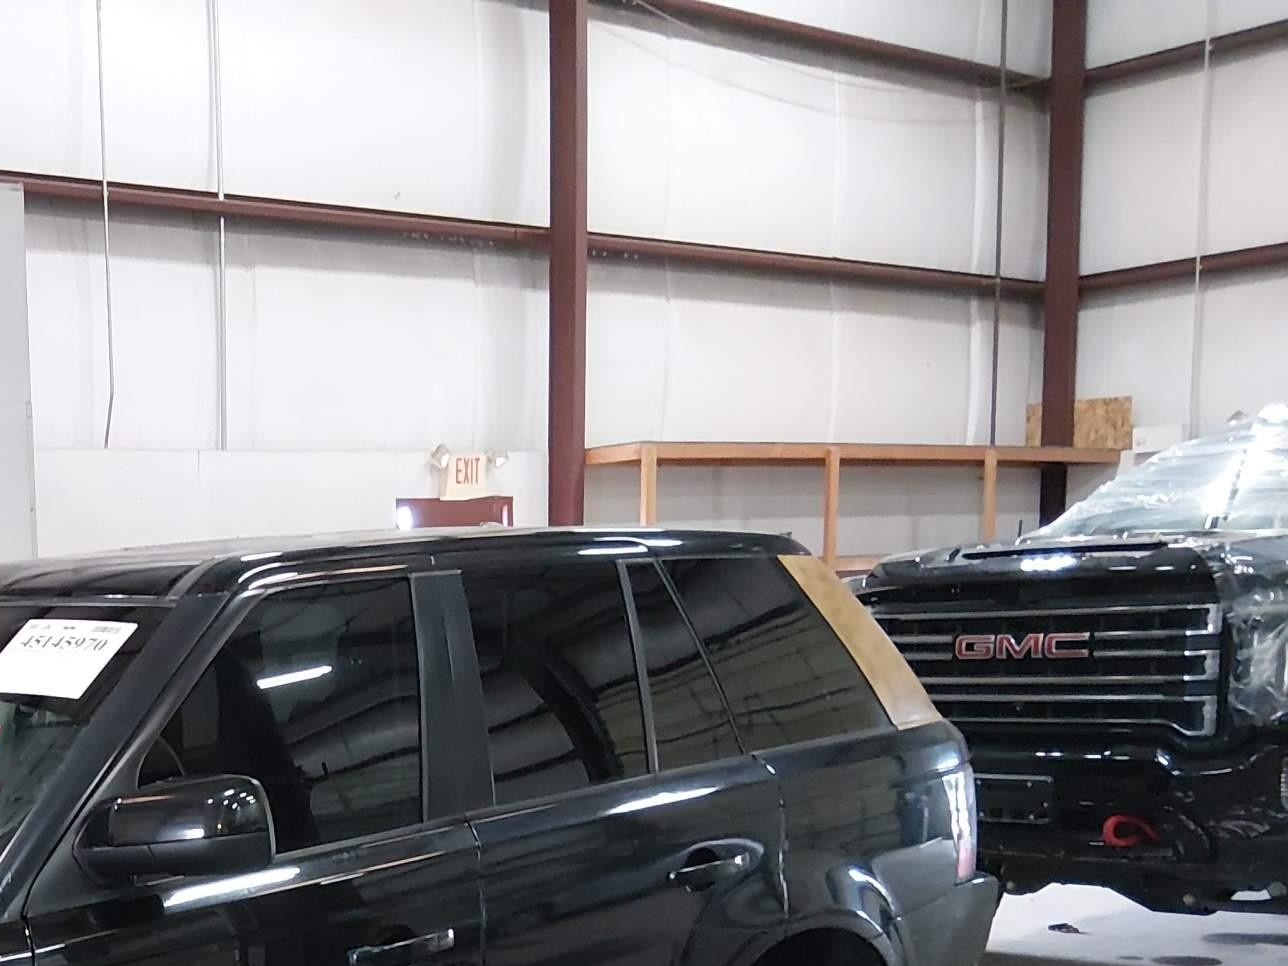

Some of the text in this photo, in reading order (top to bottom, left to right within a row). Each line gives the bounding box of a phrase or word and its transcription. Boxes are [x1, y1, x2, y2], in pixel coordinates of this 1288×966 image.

[455, 457, 481, 485] EXIT
[21, 634, 109, 652] 45145970
[954, 632, 1091, 660] GMC
